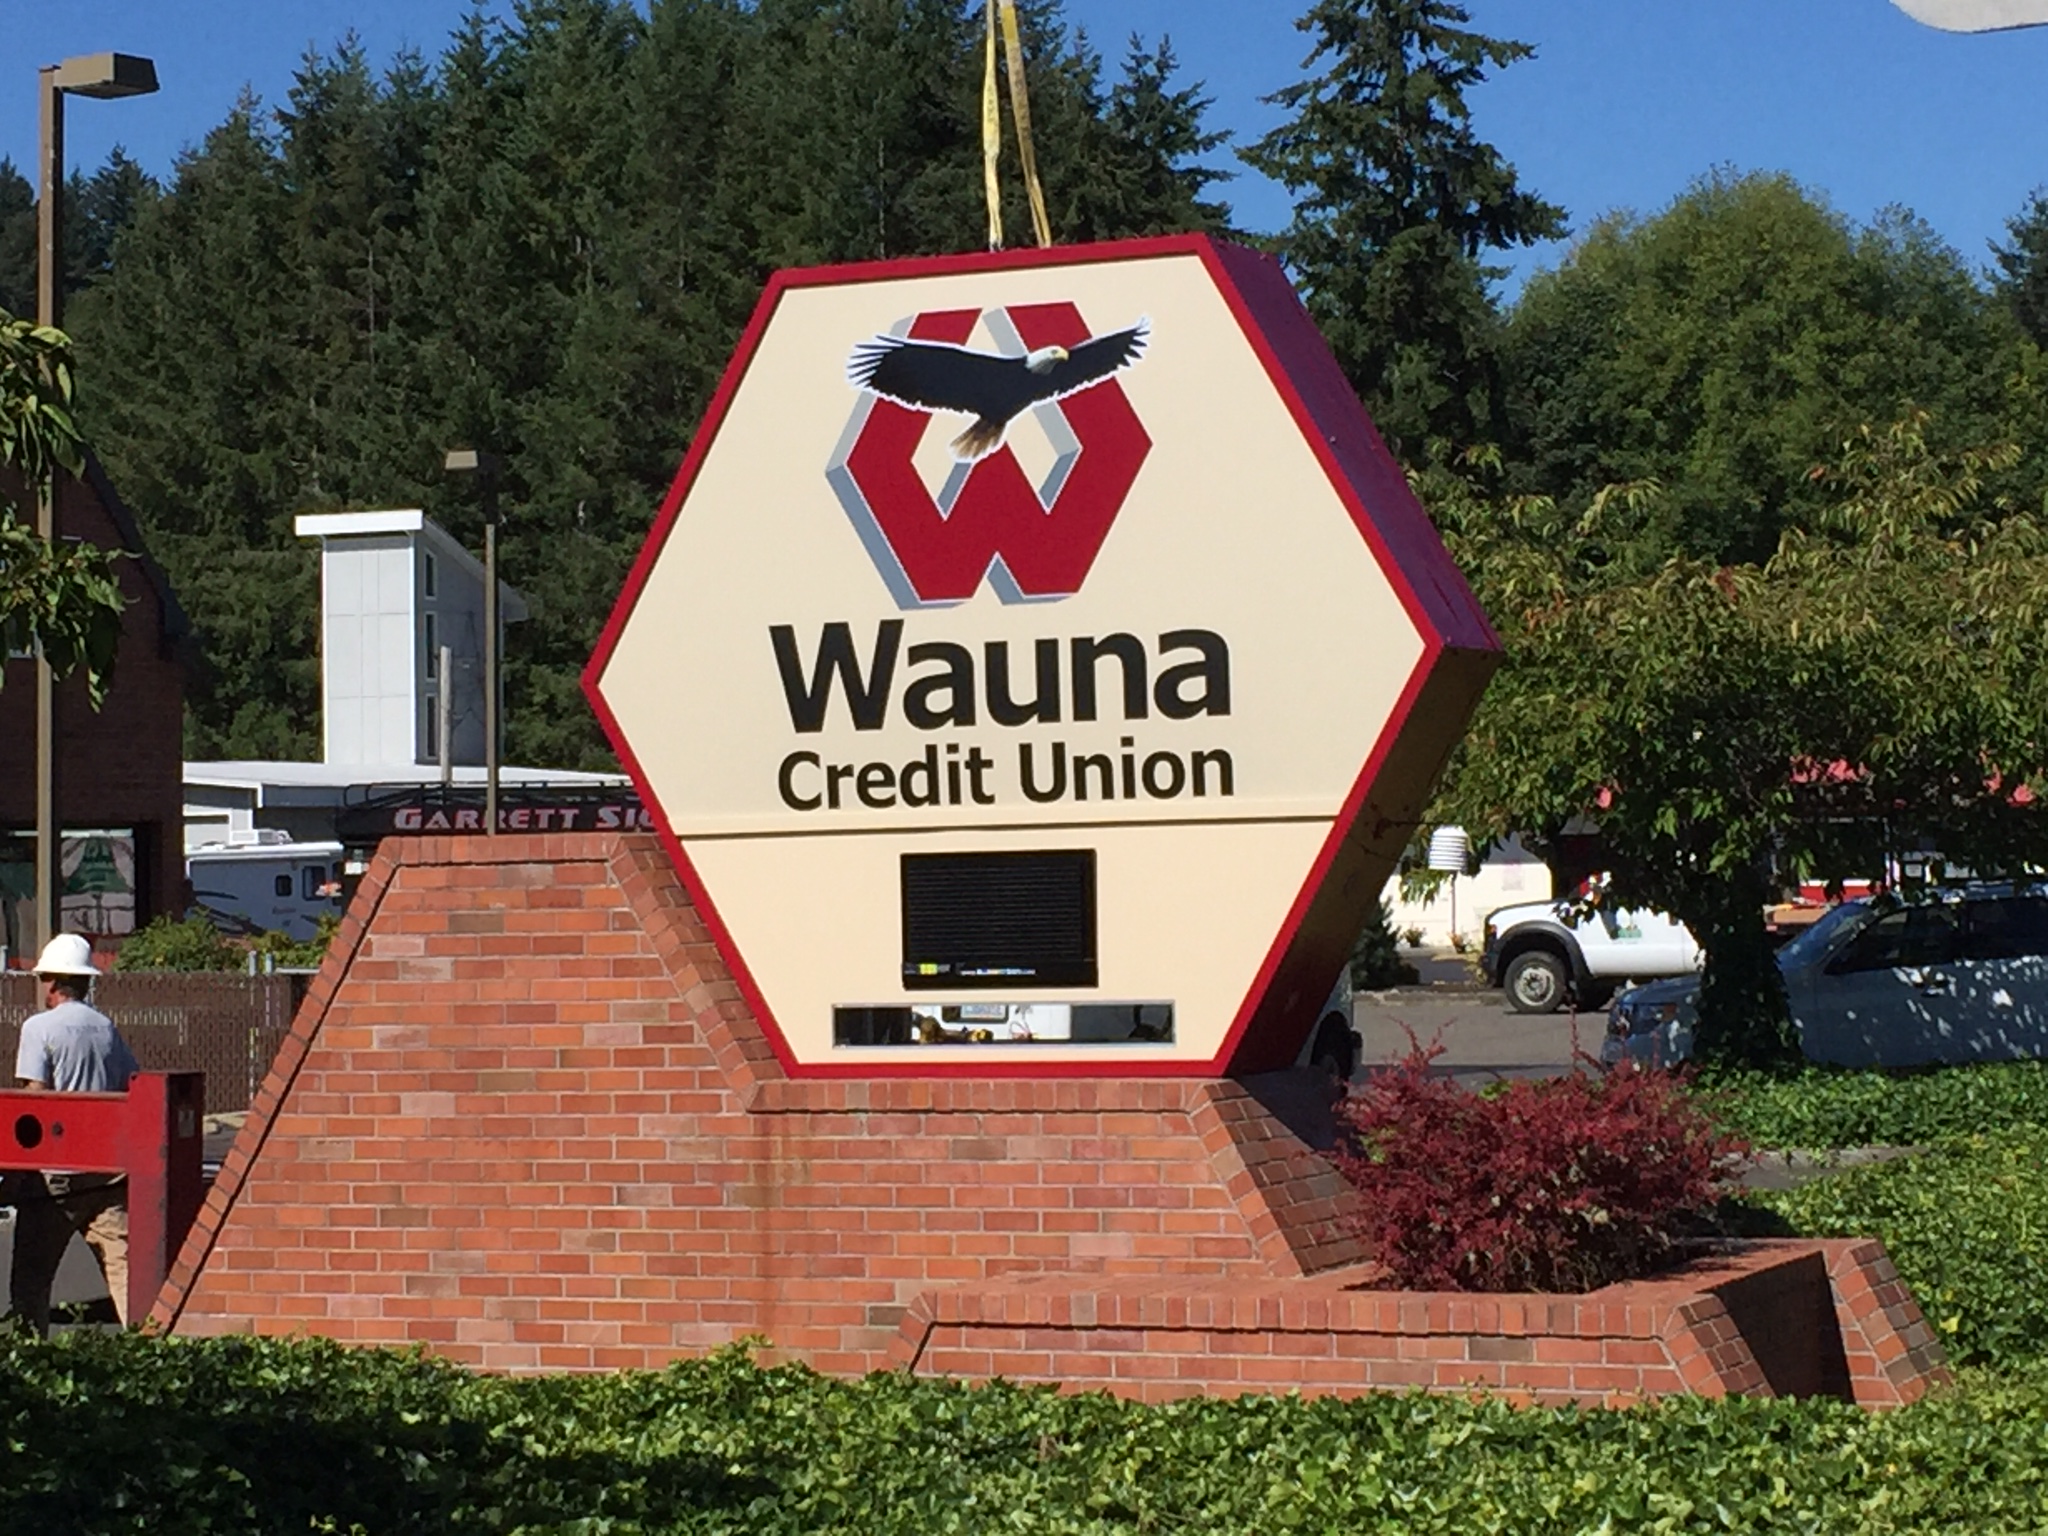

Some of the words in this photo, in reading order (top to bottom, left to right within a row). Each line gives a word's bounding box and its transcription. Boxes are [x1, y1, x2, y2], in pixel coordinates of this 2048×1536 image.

[768, 618, 1231, 734] Wauna
[778, 743, 996, 811] Credit
[1018, 736, 1234, 803] Union
